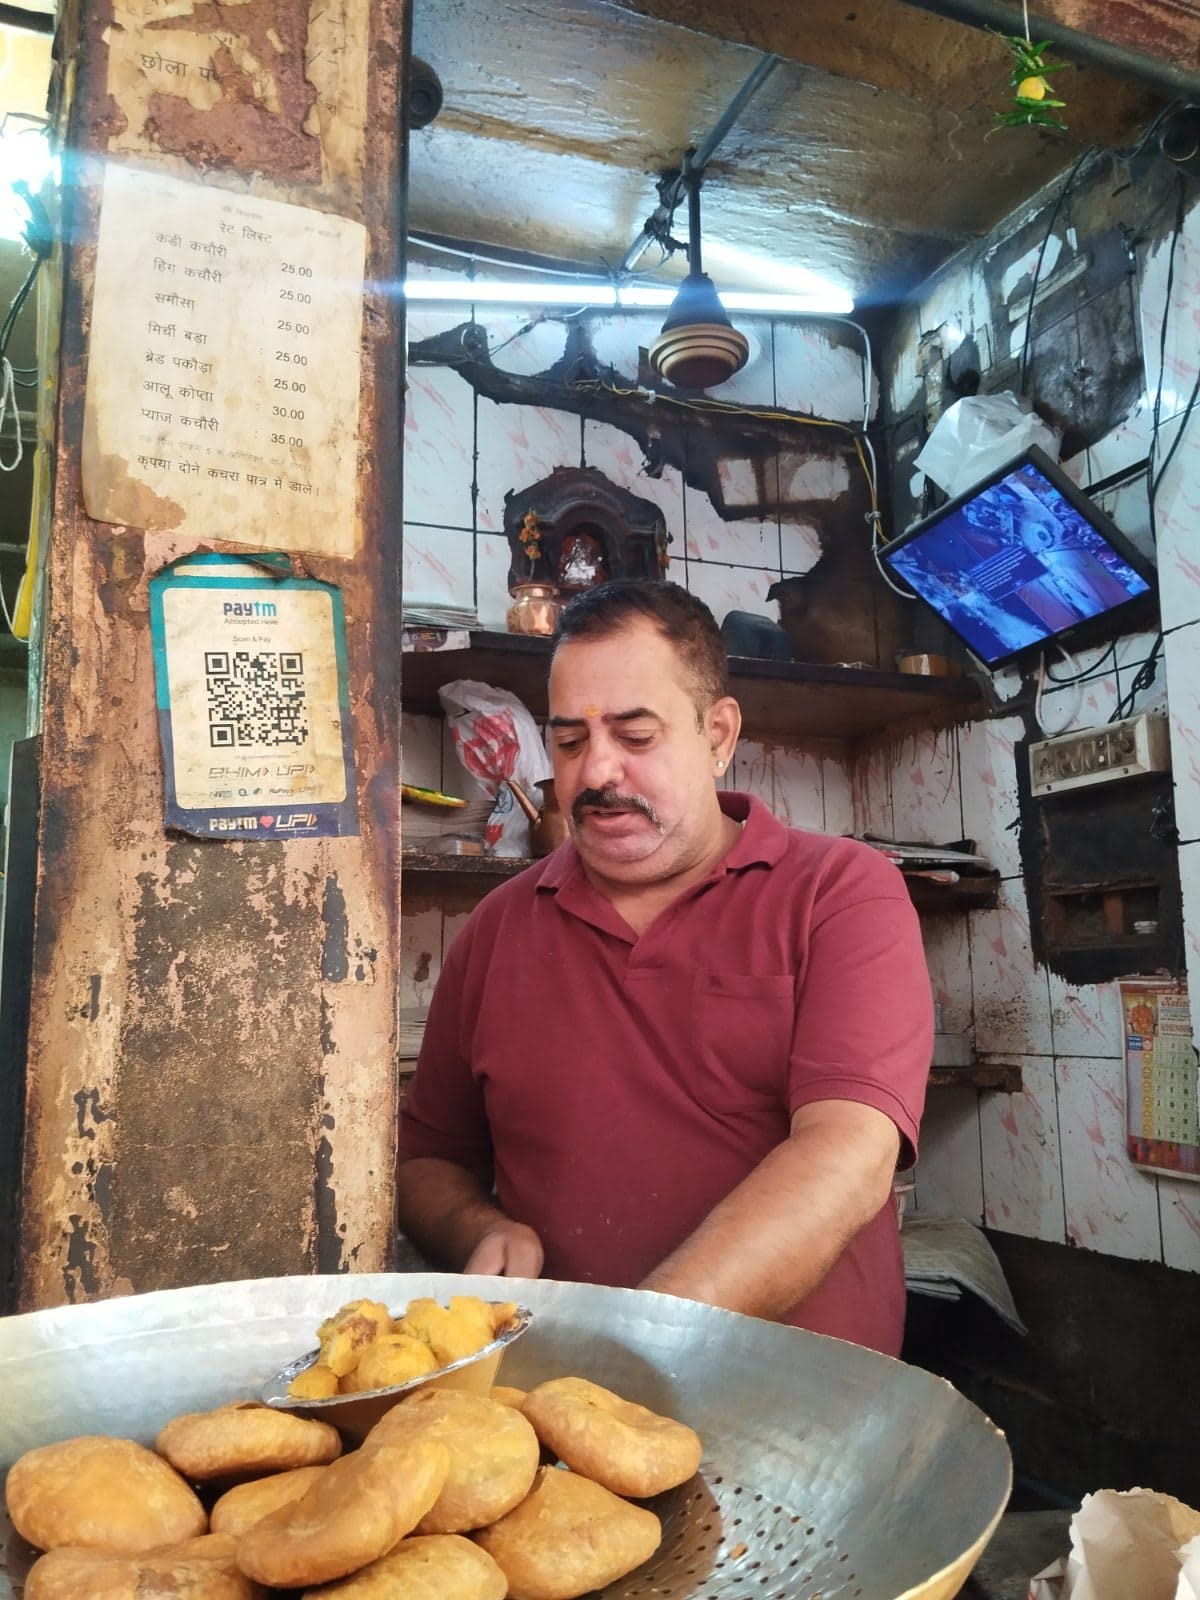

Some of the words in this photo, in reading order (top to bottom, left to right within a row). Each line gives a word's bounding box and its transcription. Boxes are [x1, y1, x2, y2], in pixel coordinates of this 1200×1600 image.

[140, 52, 188, 77] छोला
[241, 226, 272, 245] लिस्ट
[184, 266, 222, 284] कचौरी
[279, 289, 312, 305] 25.00
[281, 262, 313, 279] 25.00
[147, 320, 176, 338] मिर्ची
[275, 350, 308, 366] 25.00
[277, 319, 310, 336] 25.00
[145, 348, 167, 366] ब्रेड
[273, 378, 307, 394] 25.00
[142, 380, 173, 400] आलू
[272, 405, 306, 422] 30.00
[141, 408, 173, 425] प्याज
[180, 414, 219, 433] कचौरी
[270, 432, 304, 449] 35.00
[138, 453, 171, 471] कृपया
[179, 459, 200, 476] दोने
[207, 467, 240, 482] कचरा
[246, 473, 268, 488] पात्र
